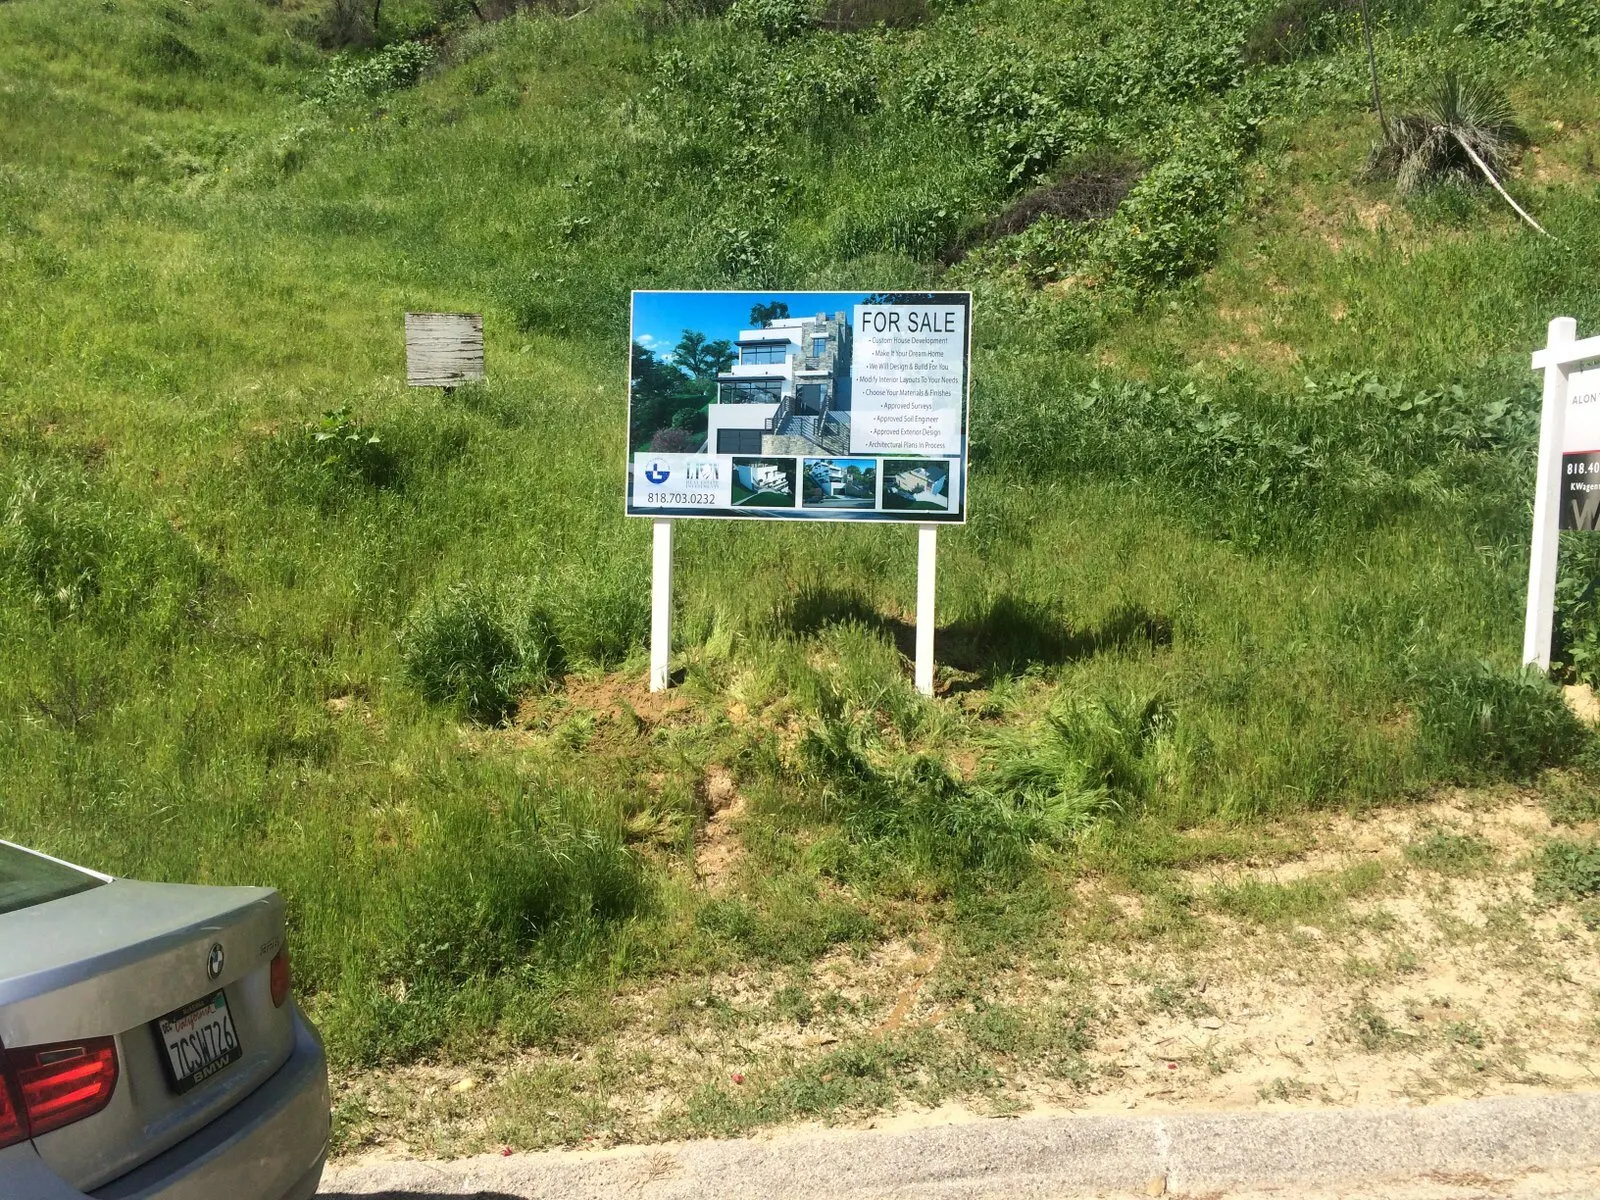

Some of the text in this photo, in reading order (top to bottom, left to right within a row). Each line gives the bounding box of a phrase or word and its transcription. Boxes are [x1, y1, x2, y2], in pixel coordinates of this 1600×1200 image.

[862, 312, 955, 333] FOR SALE
[872, 336, 948, 345] Custom House Development
[890, 363, 908, 372] Design
[860, 376, 878, 384] Modify
[900, 376, 921, 385] Layouts
[930, 389, 951, 397] Finishes
[1572, 393, 1597, 405] ALON
[884, 402, 932, 411] Approved Surveys
[876, 416, 903, 424] Approved
[915, 416, 939, 424] Engineer
[873, 428, 900, 437] Approved
[922, 429, 941, 437] Design
[647, 493, 716, 504] 818.703.0232
[1572, 498, 1600, 530] W
[170, 1015, 234, 1076] 7CSW726
[193, 1054, 230, 1083] BMW
